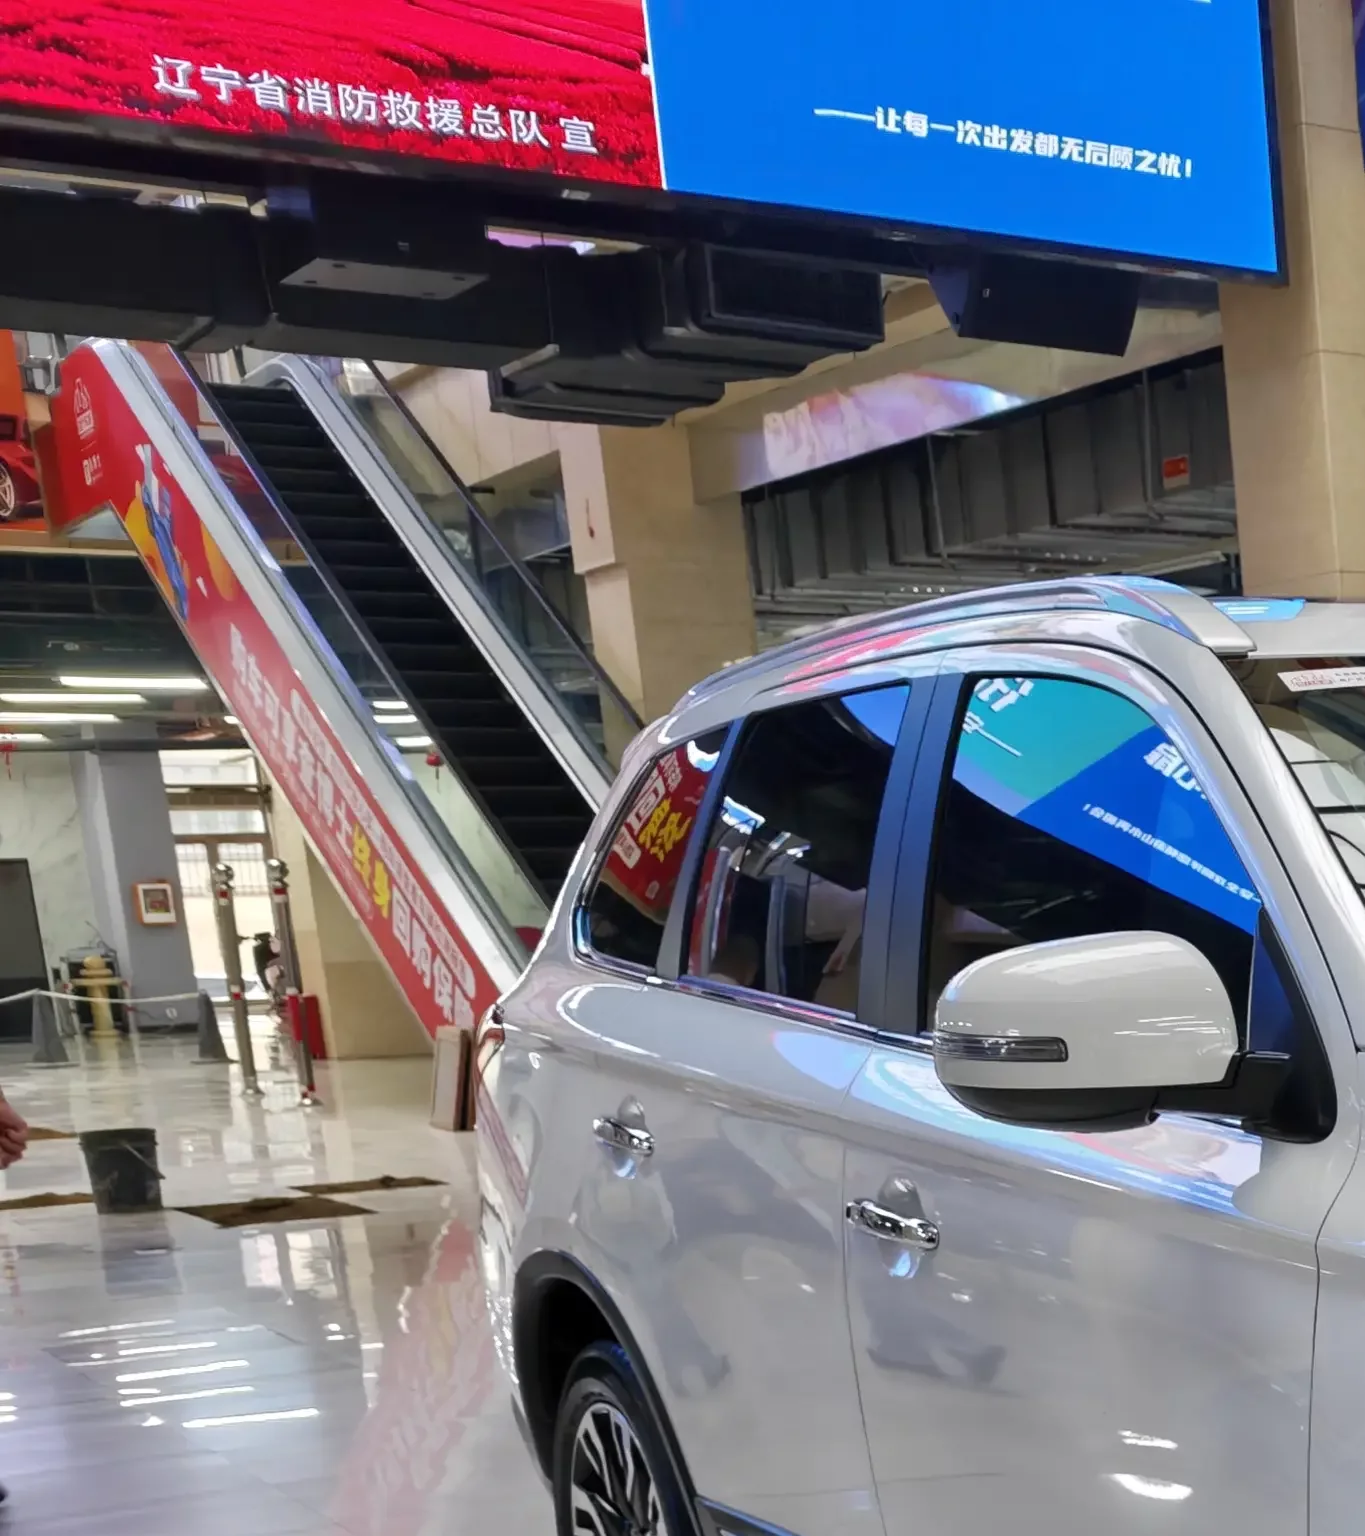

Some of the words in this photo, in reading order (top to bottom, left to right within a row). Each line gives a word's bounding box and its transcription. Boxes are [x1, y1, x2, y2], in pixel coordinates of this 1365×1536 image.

[151, 53, 550, 148] 辽宁省消防救援总队
[560, 116, 599, 155] 宣
